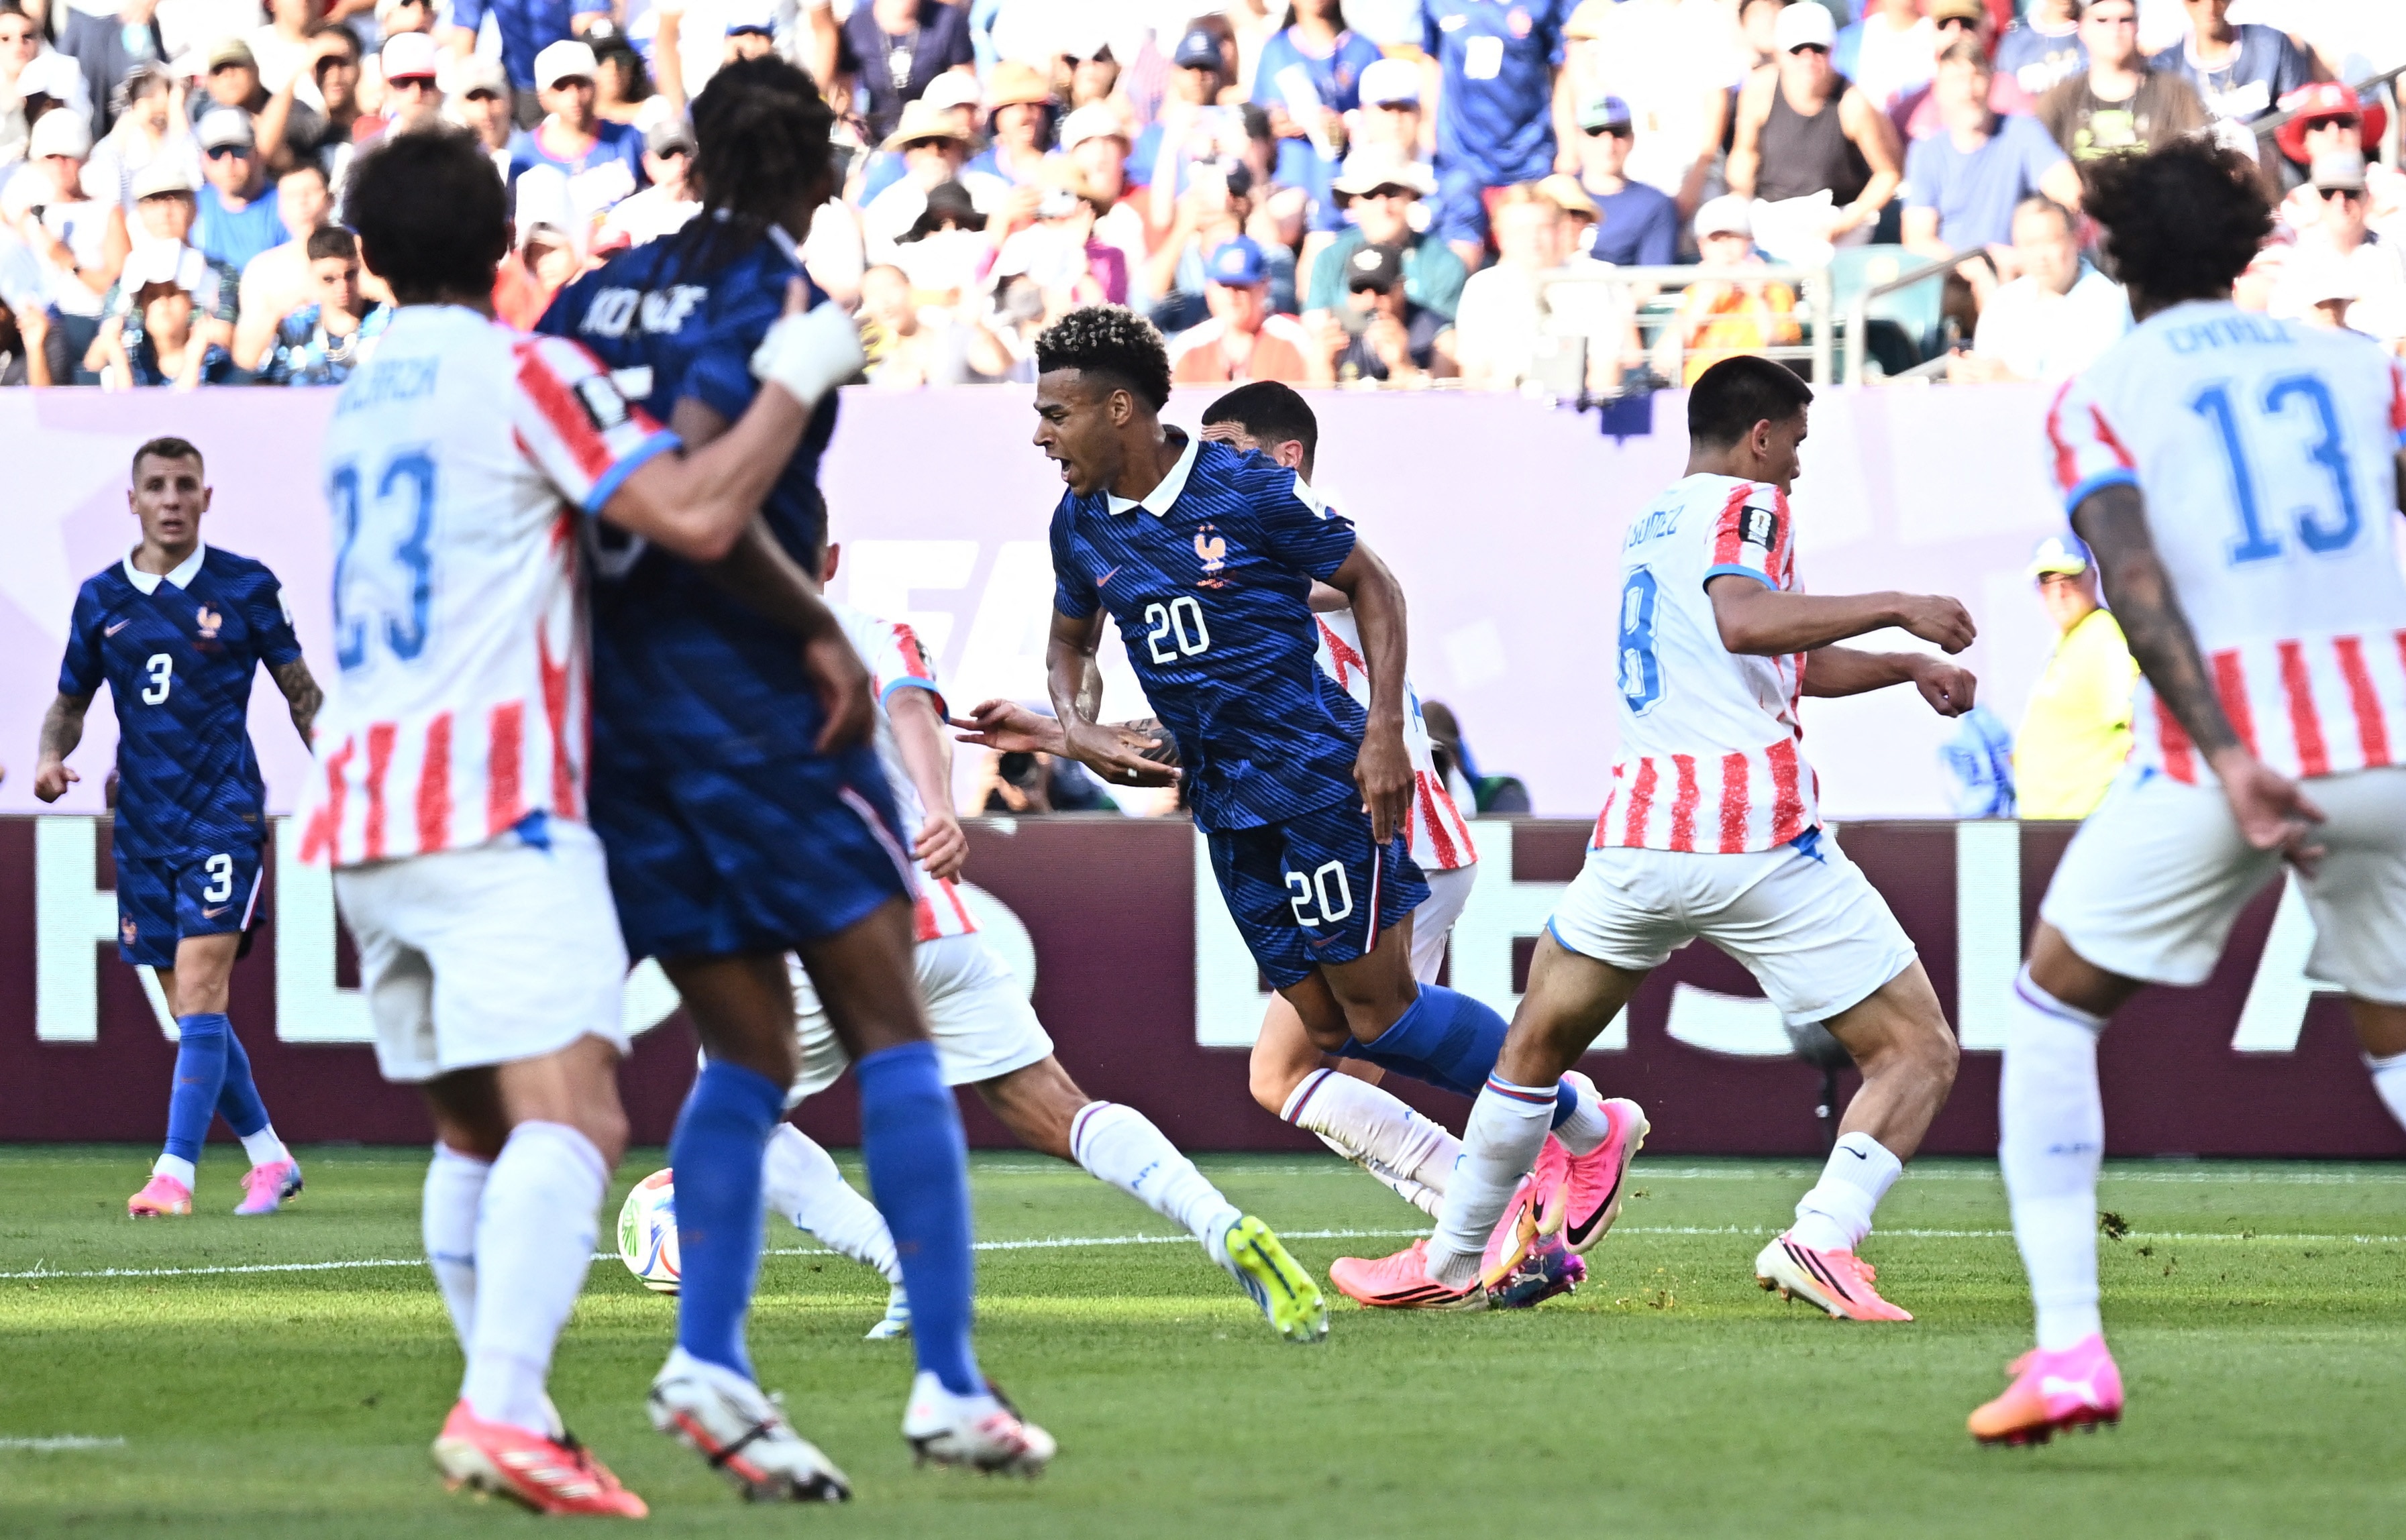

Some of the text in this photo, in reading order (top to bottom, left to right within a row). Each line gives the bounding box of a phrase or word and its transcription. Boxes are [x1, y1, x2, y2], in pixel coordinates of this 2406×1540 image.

[2189, 373, 2363, 565] 13
[329, 445, 437, 671] 23
[1144, 595, 1210, 665] 20
[1617, 565, 1666, 718] 8
[142, 653, 173, 706] 3
[203, 853, 233, 903] 3
[1284, 859, 1354, 927] 20
